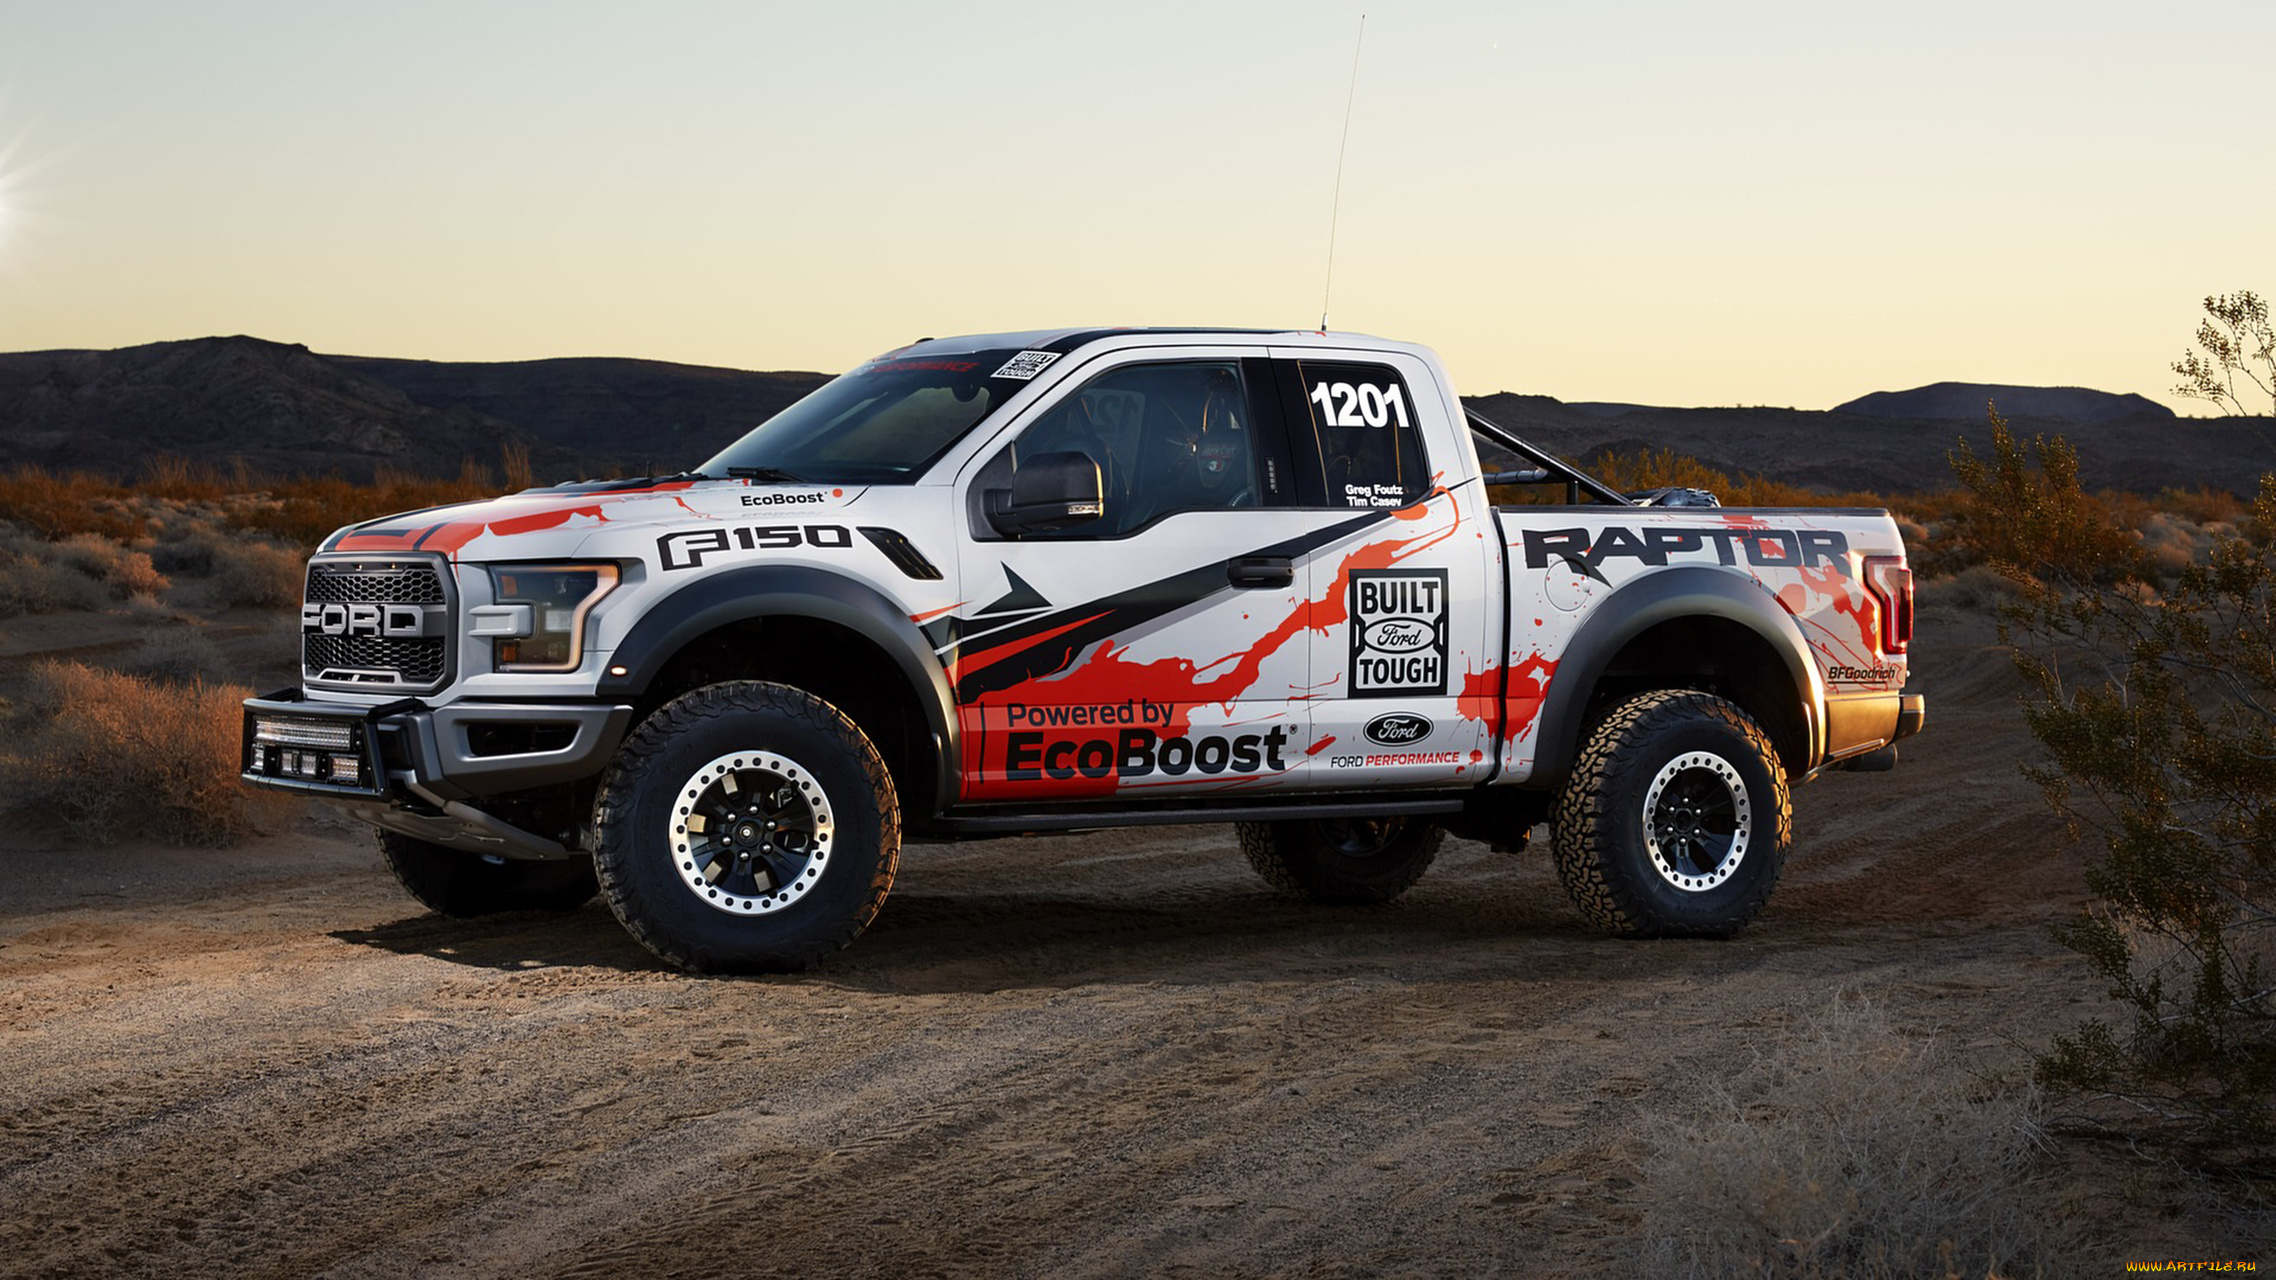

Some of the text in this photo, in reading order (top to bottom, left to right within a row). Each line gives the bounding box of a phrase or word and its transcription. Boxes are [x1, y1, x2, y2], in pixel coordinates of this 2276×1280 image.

[1015, 353, 1056, 364] BUILT
[997, 368, 1036, 377] TOUGH
[1310, 382, 1410, 428] 1201
[740, 492, 824, 506] EcoBoost
[1345, 484, 1403, 497] Greg Foutz
[1346, 496, 1368, 506] Tim
[1522, 527, 1852, 589] RAPTOR
[1361, 581, 1439, 614] BUILT
[302, 604, 423, 636] FORD
[1377, 623, 1422, 646] Ford
[1359, 657, 1438, 685] TOUGH
[1828, 665, 1895, 679] BFGoodrich
[1007, 699, 1174, 728] Powered by
[1378, 718, 1419, 739] Ford
[1006, 724, 1288, 782] EcoBoost
[1331, 751, 1460, 768] FORD PERFORMANCE
